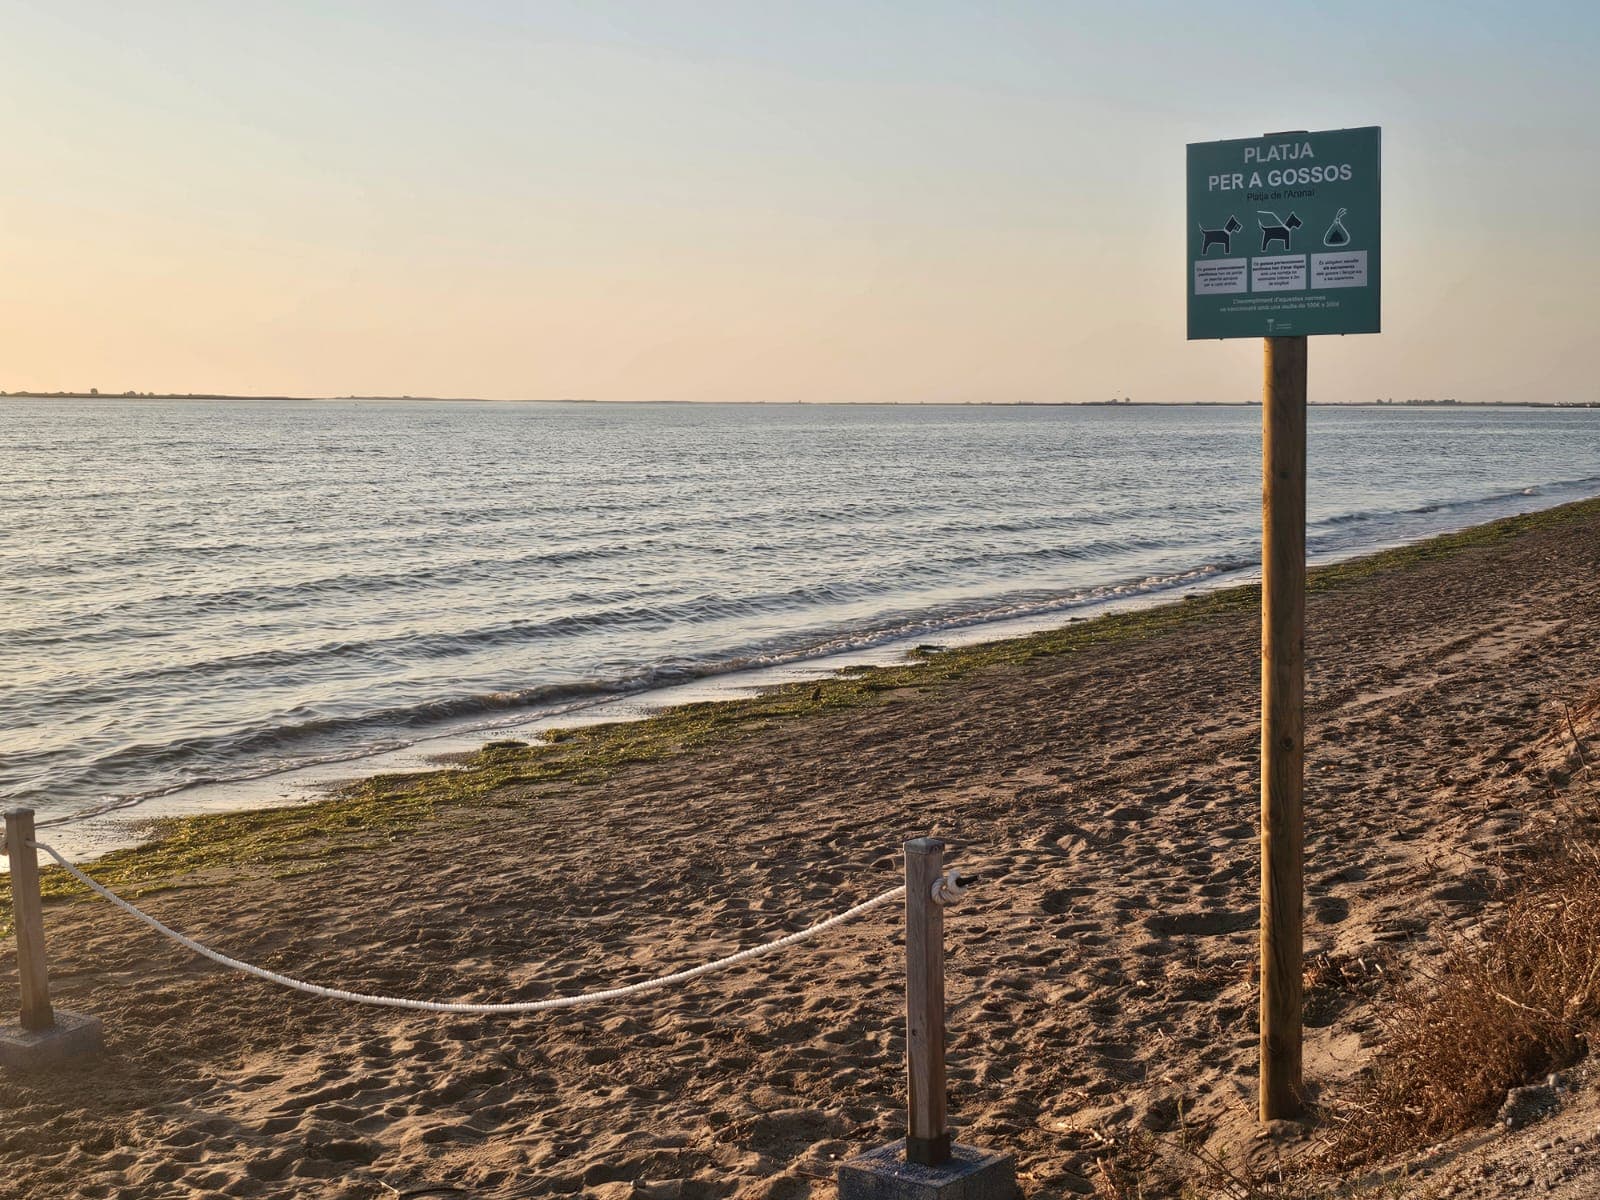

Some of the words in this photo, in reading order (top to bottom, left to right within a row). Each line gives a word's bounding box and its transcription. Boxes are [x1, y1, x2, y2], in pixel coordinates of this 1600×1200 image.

[1244, 142, 1314, 163] PLATJA
[1208, 173, 1244, 191] PER
[1249, 172, 1262, 188] A
[1267, 164, 1352, 187] GOSSOS
[1247, 192, 1269, 201] Platja
